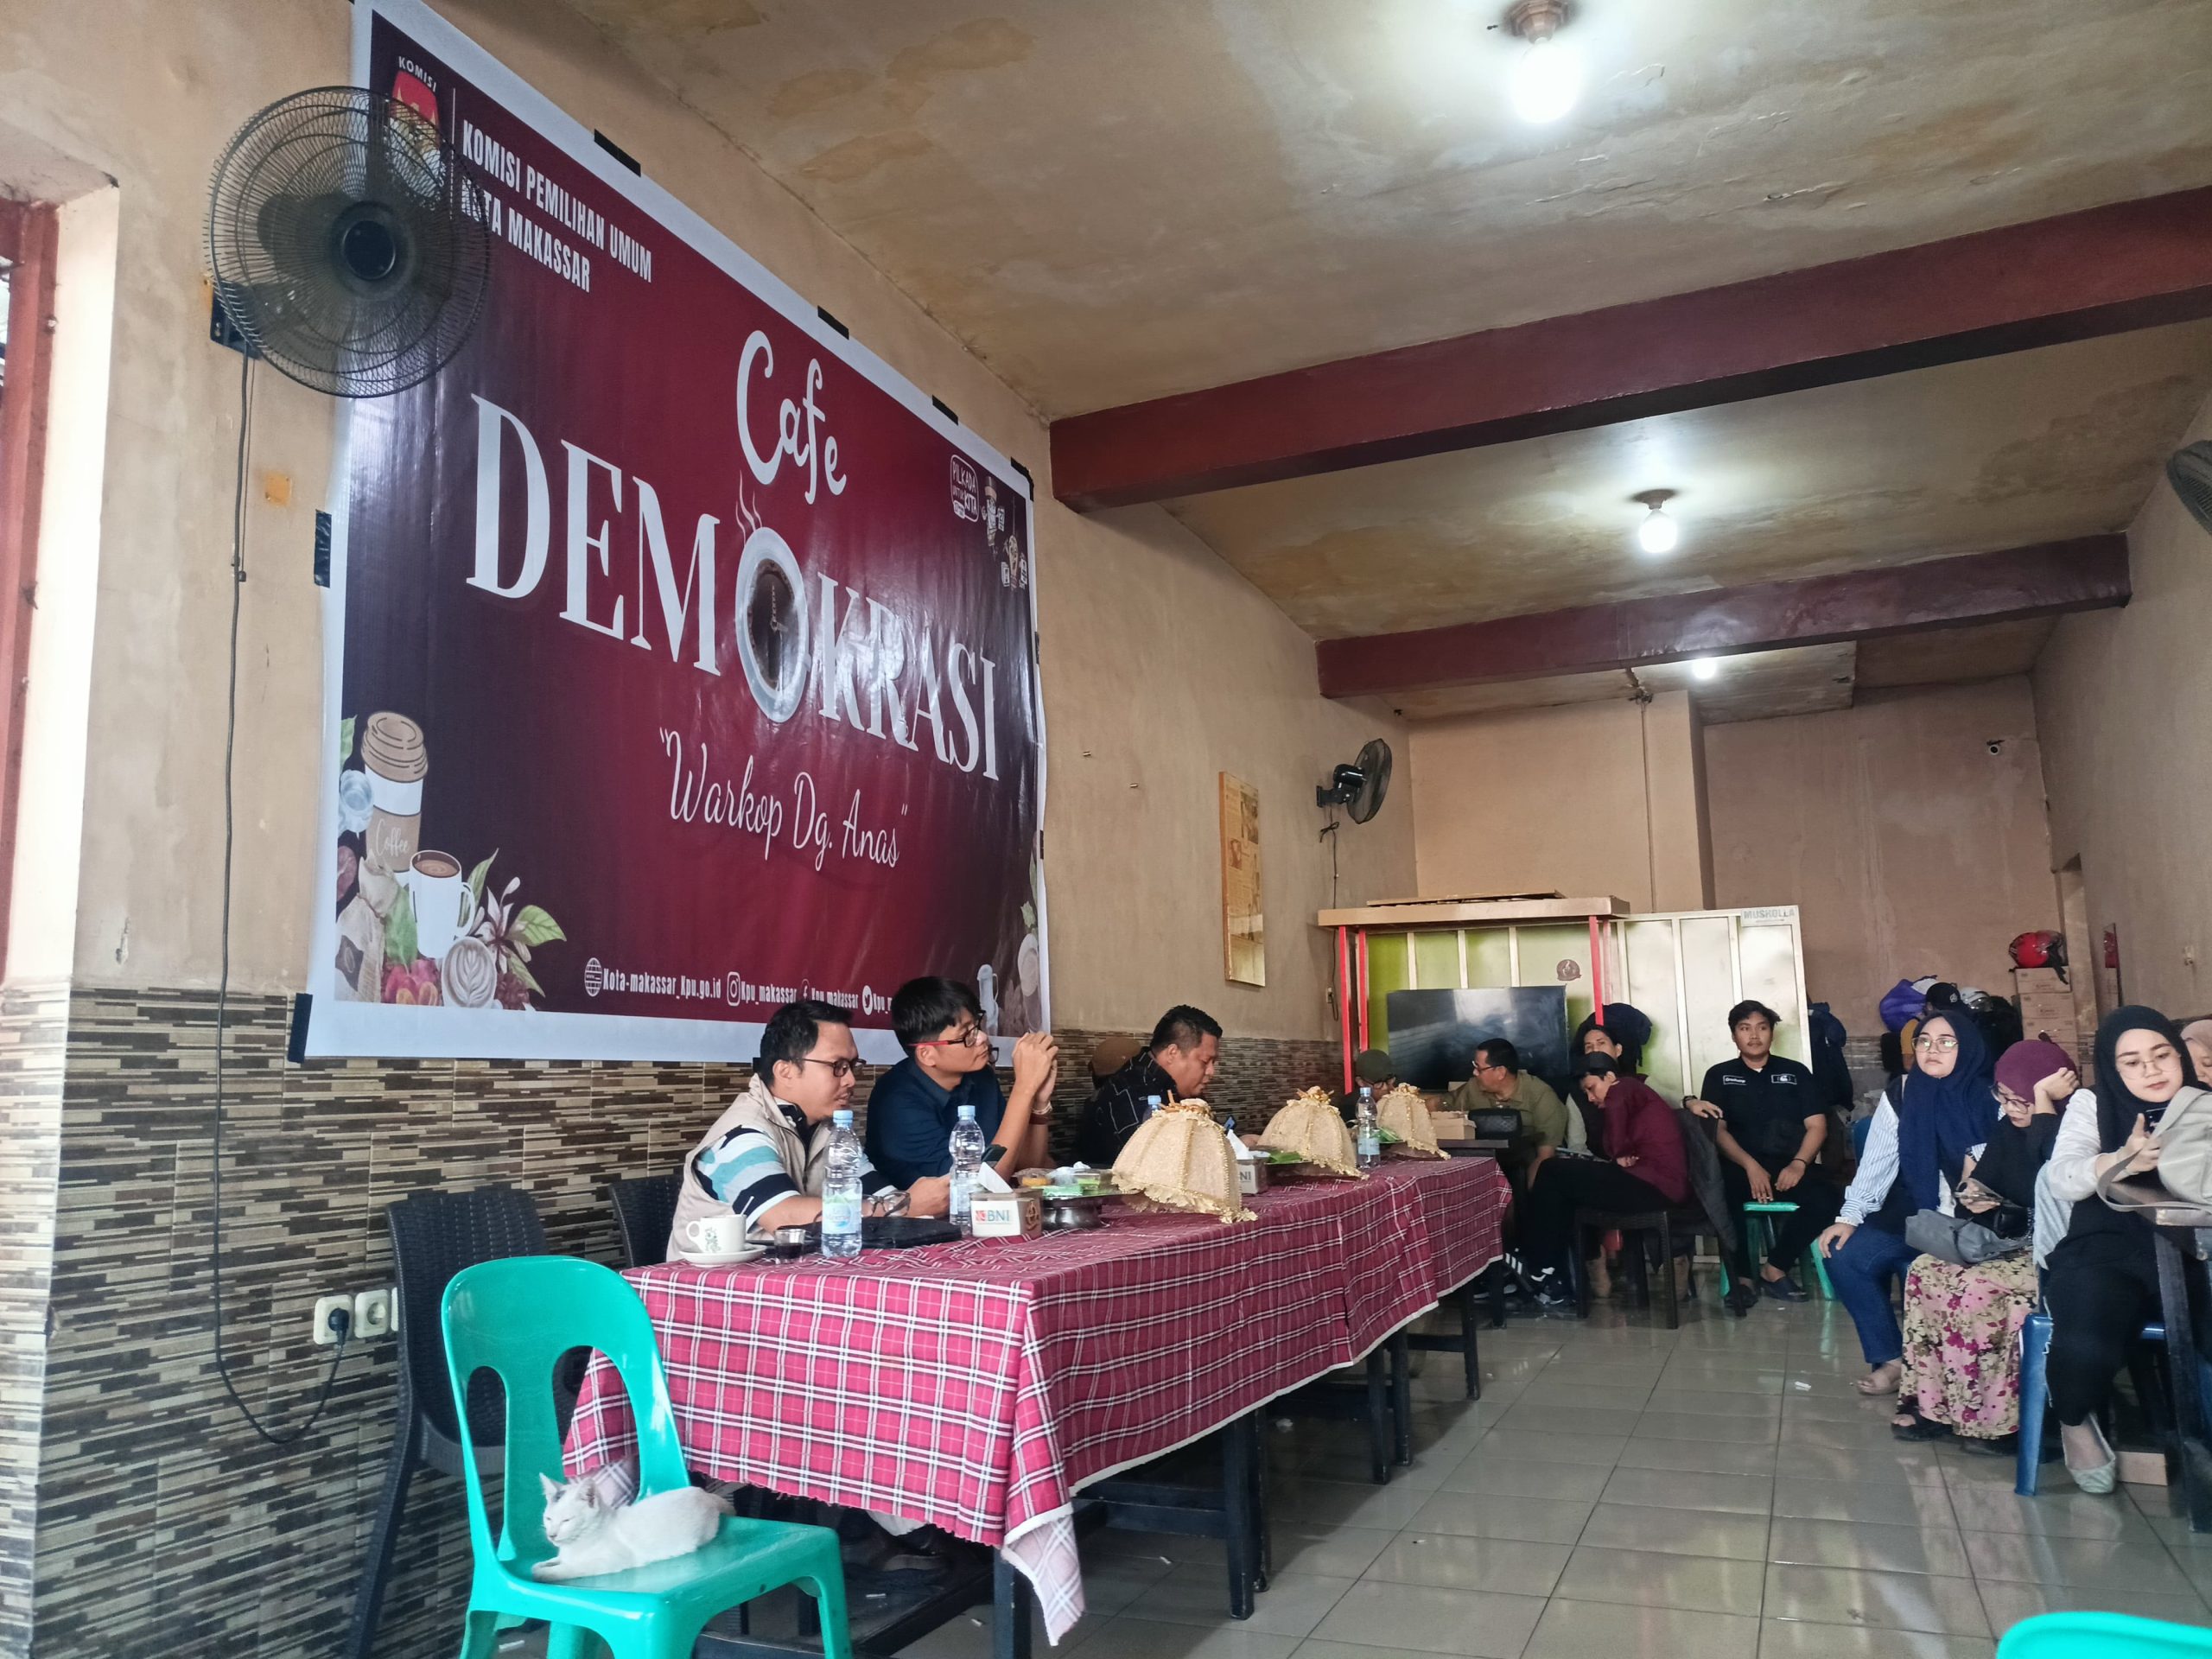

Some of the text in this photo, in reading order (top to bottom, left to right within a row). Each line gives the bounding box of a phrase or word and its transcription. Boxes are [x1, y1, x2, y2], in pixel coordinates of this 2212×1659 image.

[398, 55, 437, 93] KOMISI
[462, 118, 652, 283] KOMISI PEMILIHAN UMUM
[508, 207, 591, 294] MAKASSAR
[736, 329, 848, 505] Cafe
[953, 461, 976, 493] PILKADA
[964, 490, 976, 515] KITA
[465, 392, 1000, 782] DEMOKRASI
[792, 771, 834, 873] Dg.
[987, 1210, 1010, 1222] BNI
